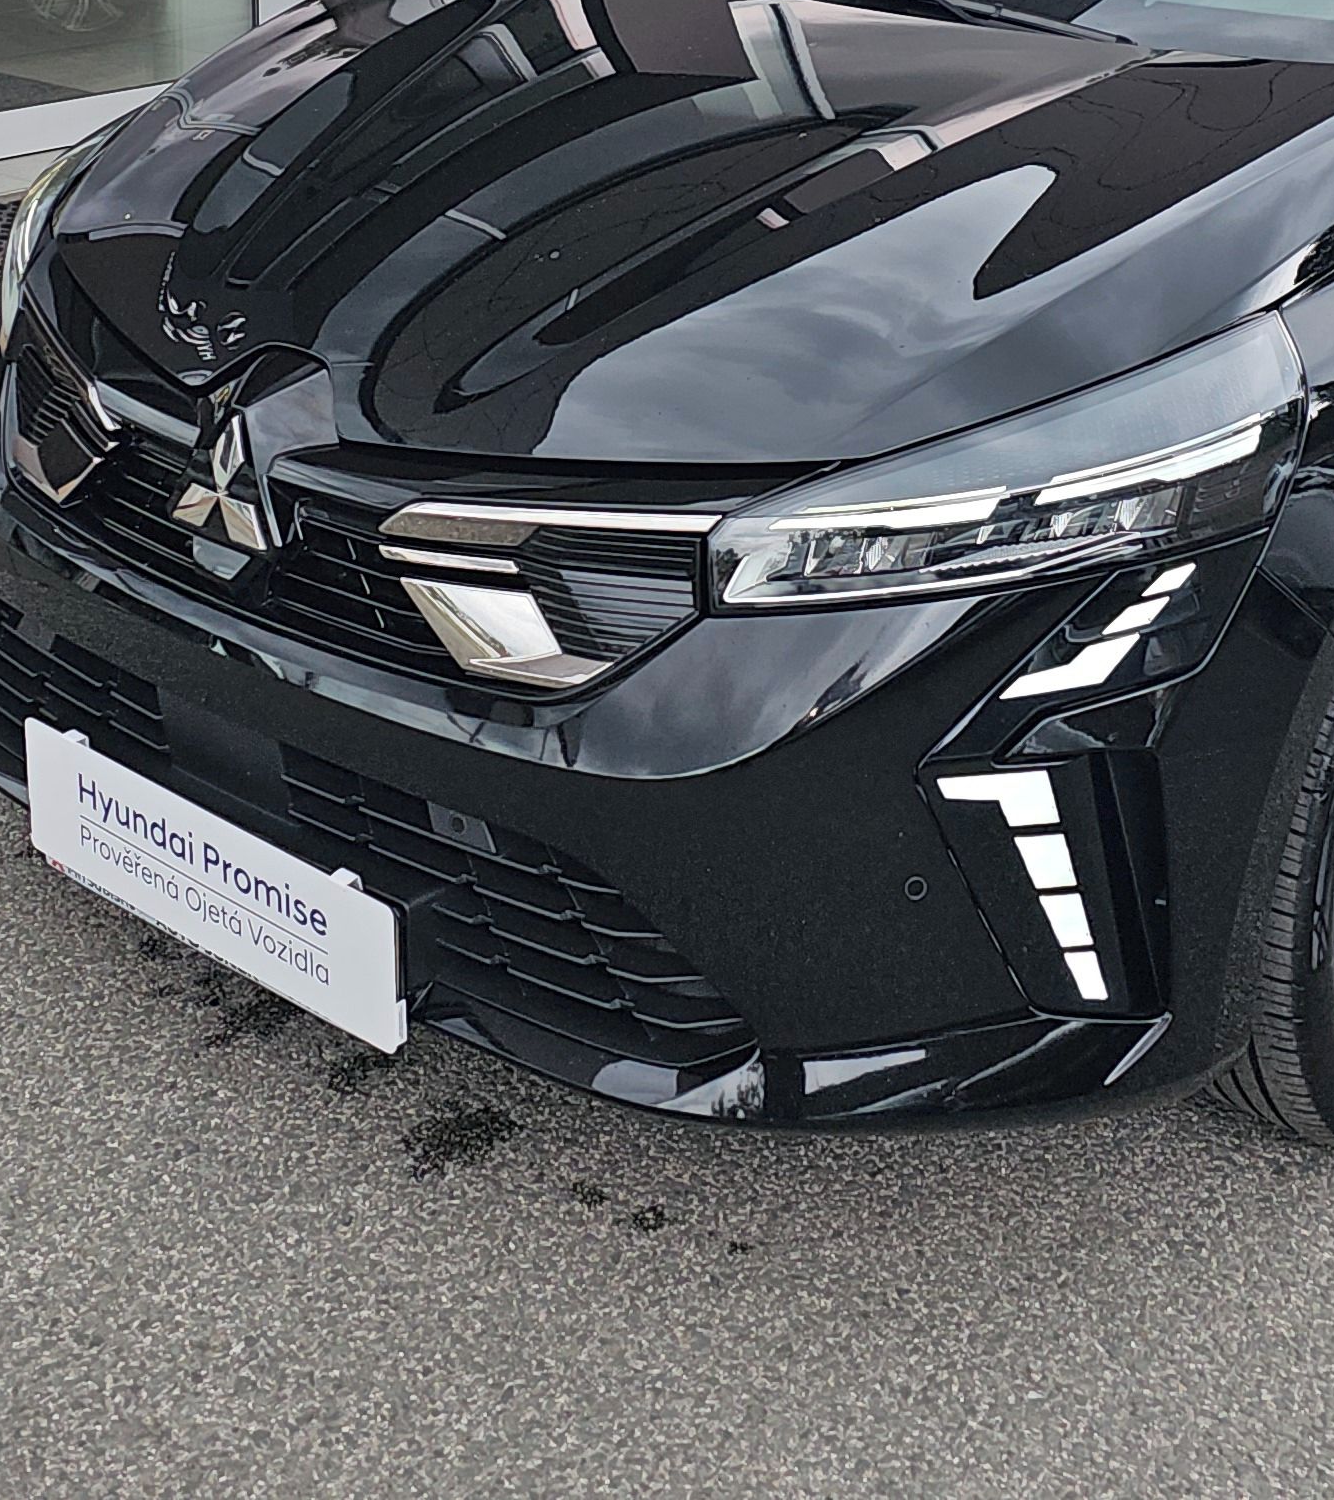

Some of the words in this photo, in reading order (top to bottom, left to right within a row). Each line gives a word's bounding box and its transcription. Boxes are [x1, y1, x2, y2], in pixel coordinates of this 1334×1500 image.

[77, 773, 194, 866] Hyundai
[204, 841, 328, 936] Promise
[80, 825, 178, 902] Prověřená
[185, 887, 243, 937] Ojetá
[248, 912, 330, 986] Vozidla
